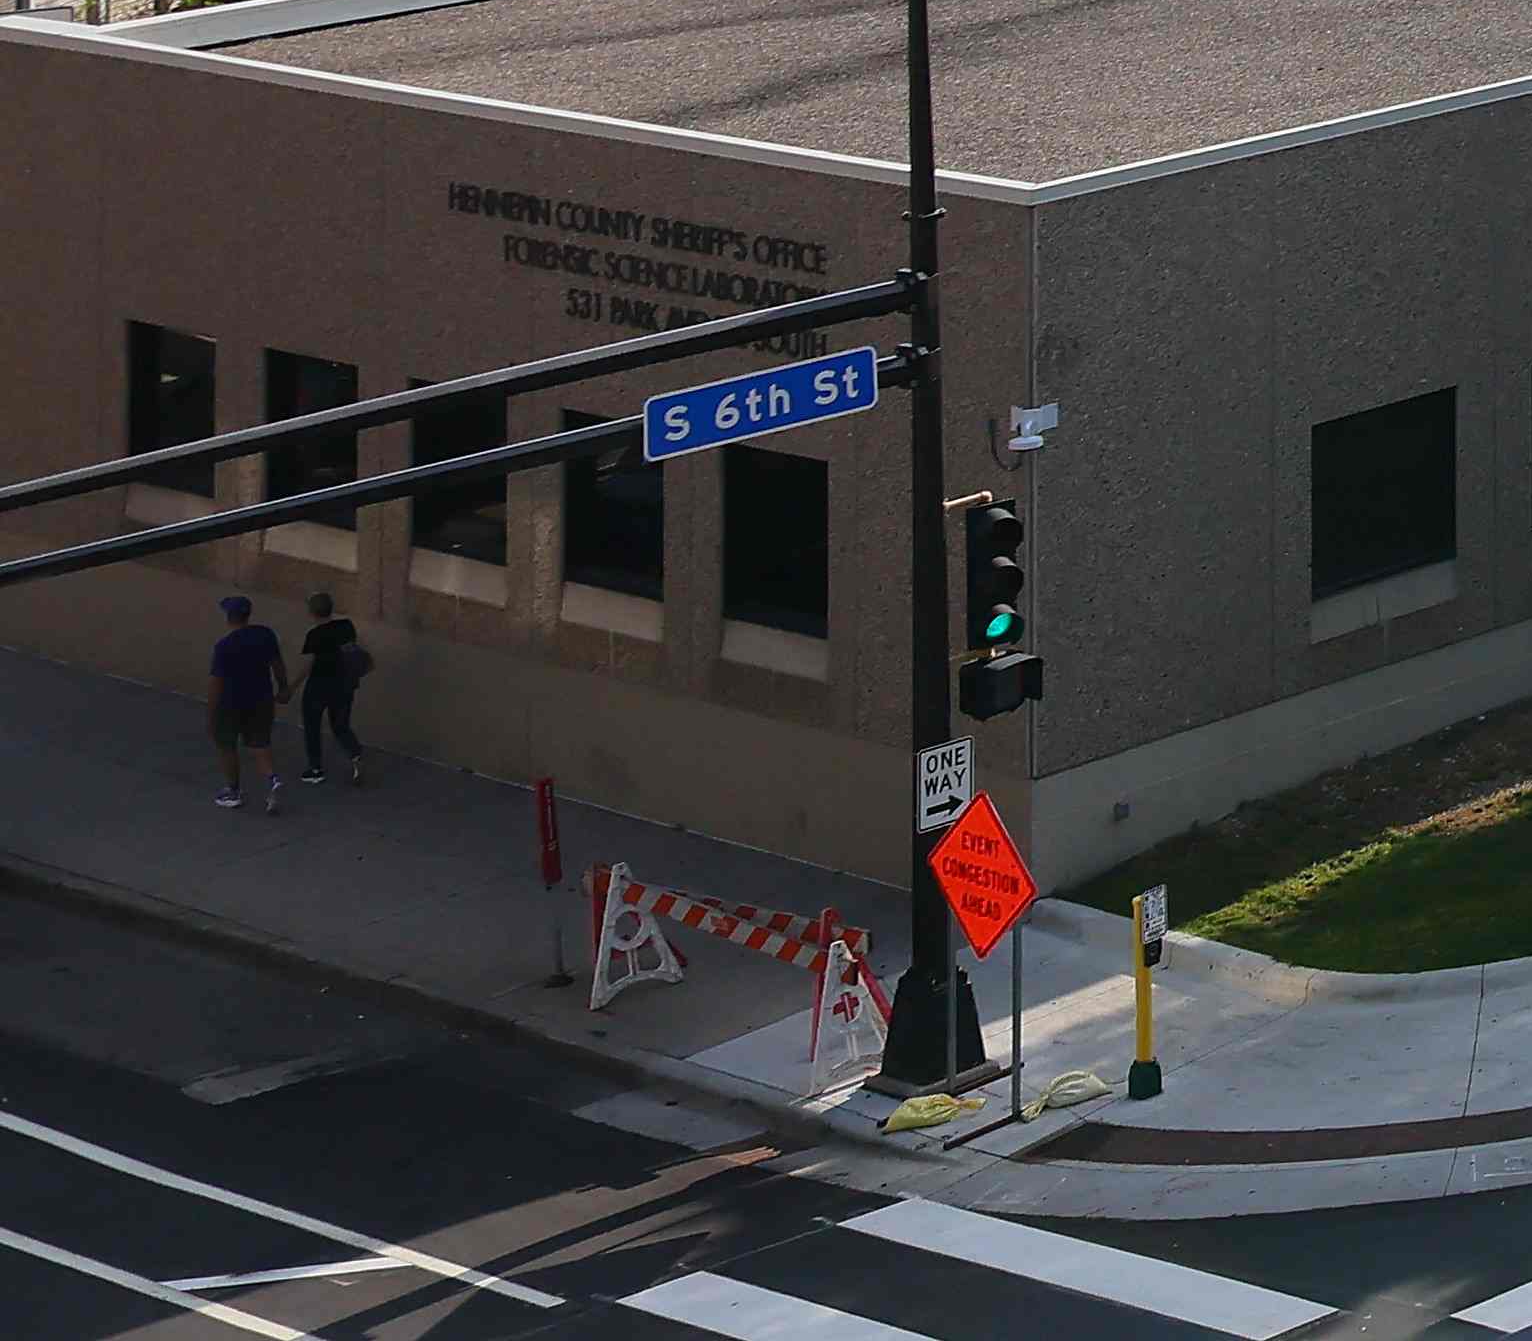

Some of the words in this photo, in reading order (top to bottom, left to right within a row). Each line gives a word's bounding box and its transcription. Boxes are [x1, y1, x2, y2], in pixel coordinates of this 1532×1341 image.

[449, 181, 550, 227] HENNEPIN
[556, 201, 645, 243] COUNTY
[752, 235, 828, 275] OFFICE
[503, 234, 599, 278] FORENSIC
[604, 251, 688, 291] SCIENCE
[565, 288, 602, 323] 531
[664, 405, 691, 442] S
[715, 384, 791, 430] 6th
[814, 365, 858, 406] St
[926, 746, 966, 774] ONE
[924, 768, 967, 798] WAY
[961, 830, 1001, 859] EVENT
[941, 856, 1020, 894] CONGESTION
[960, 891, 1001, 922] AHEAD
